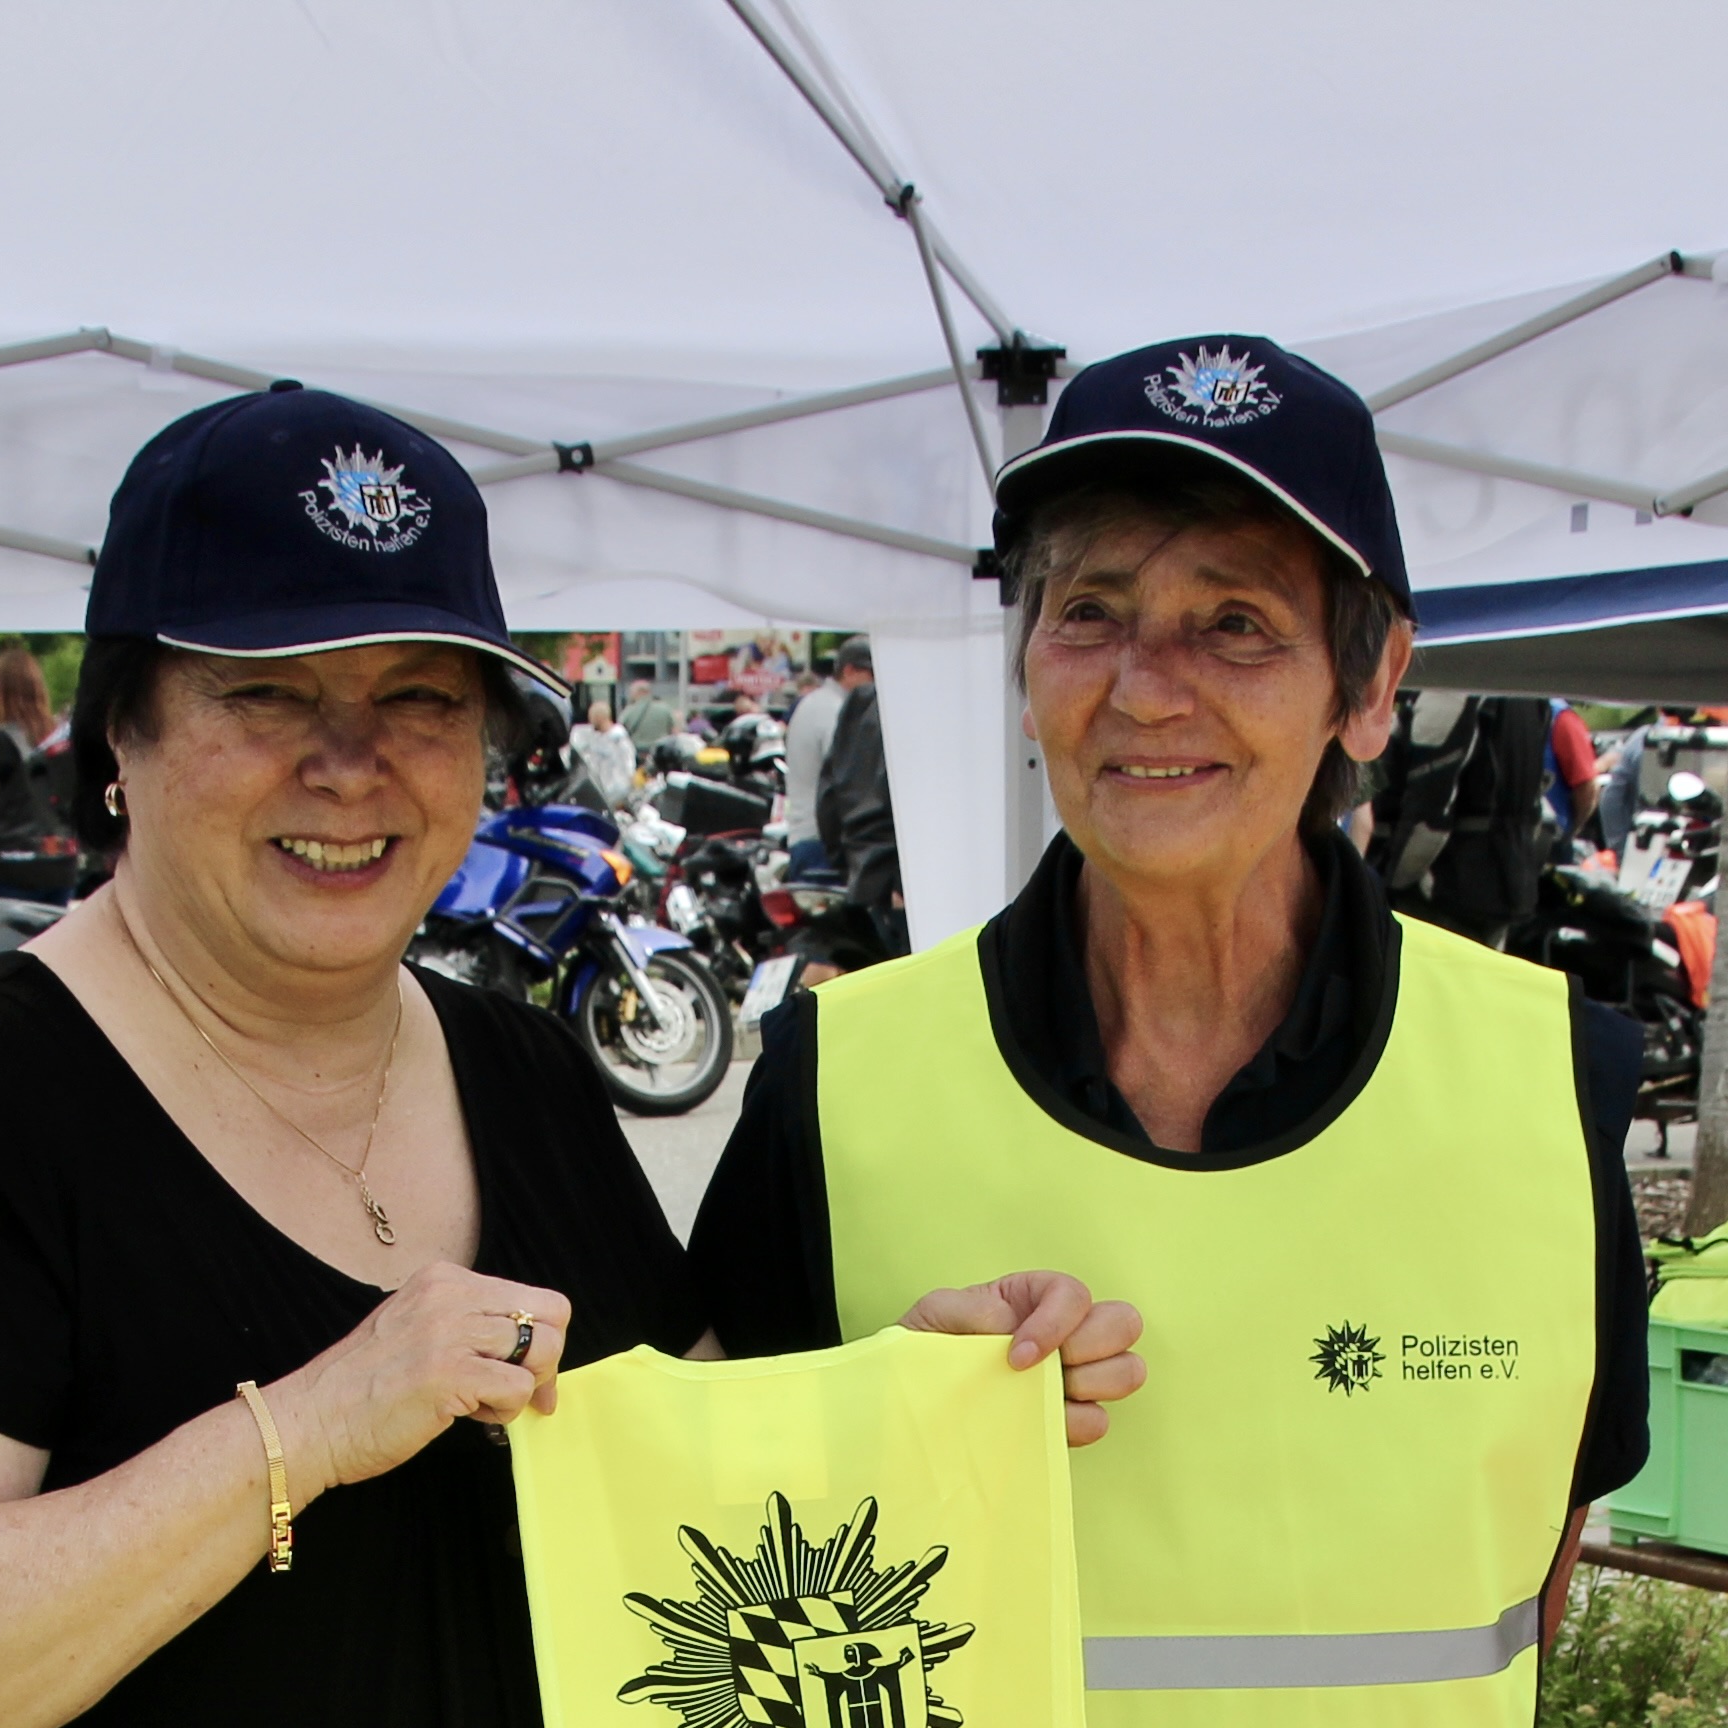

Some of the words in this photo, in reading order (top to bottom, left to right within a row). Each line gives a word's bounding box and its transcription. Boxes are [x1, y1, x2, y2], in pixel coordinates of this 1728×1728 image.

[1144, 373, 1198, 425] Polizisten
[1202, 409, 1259, 427] helfen
[298, 490, 370, 551] Polizisten
[373, 526, 422, 553] helfen
[415, 496, 432, 528] e.V.
[1402, 1334, 1519, 1357] Polizisten
[1402, 1360, 1472, 1380] helfen
[1480, 1359, 1519, 1380] e.V.
